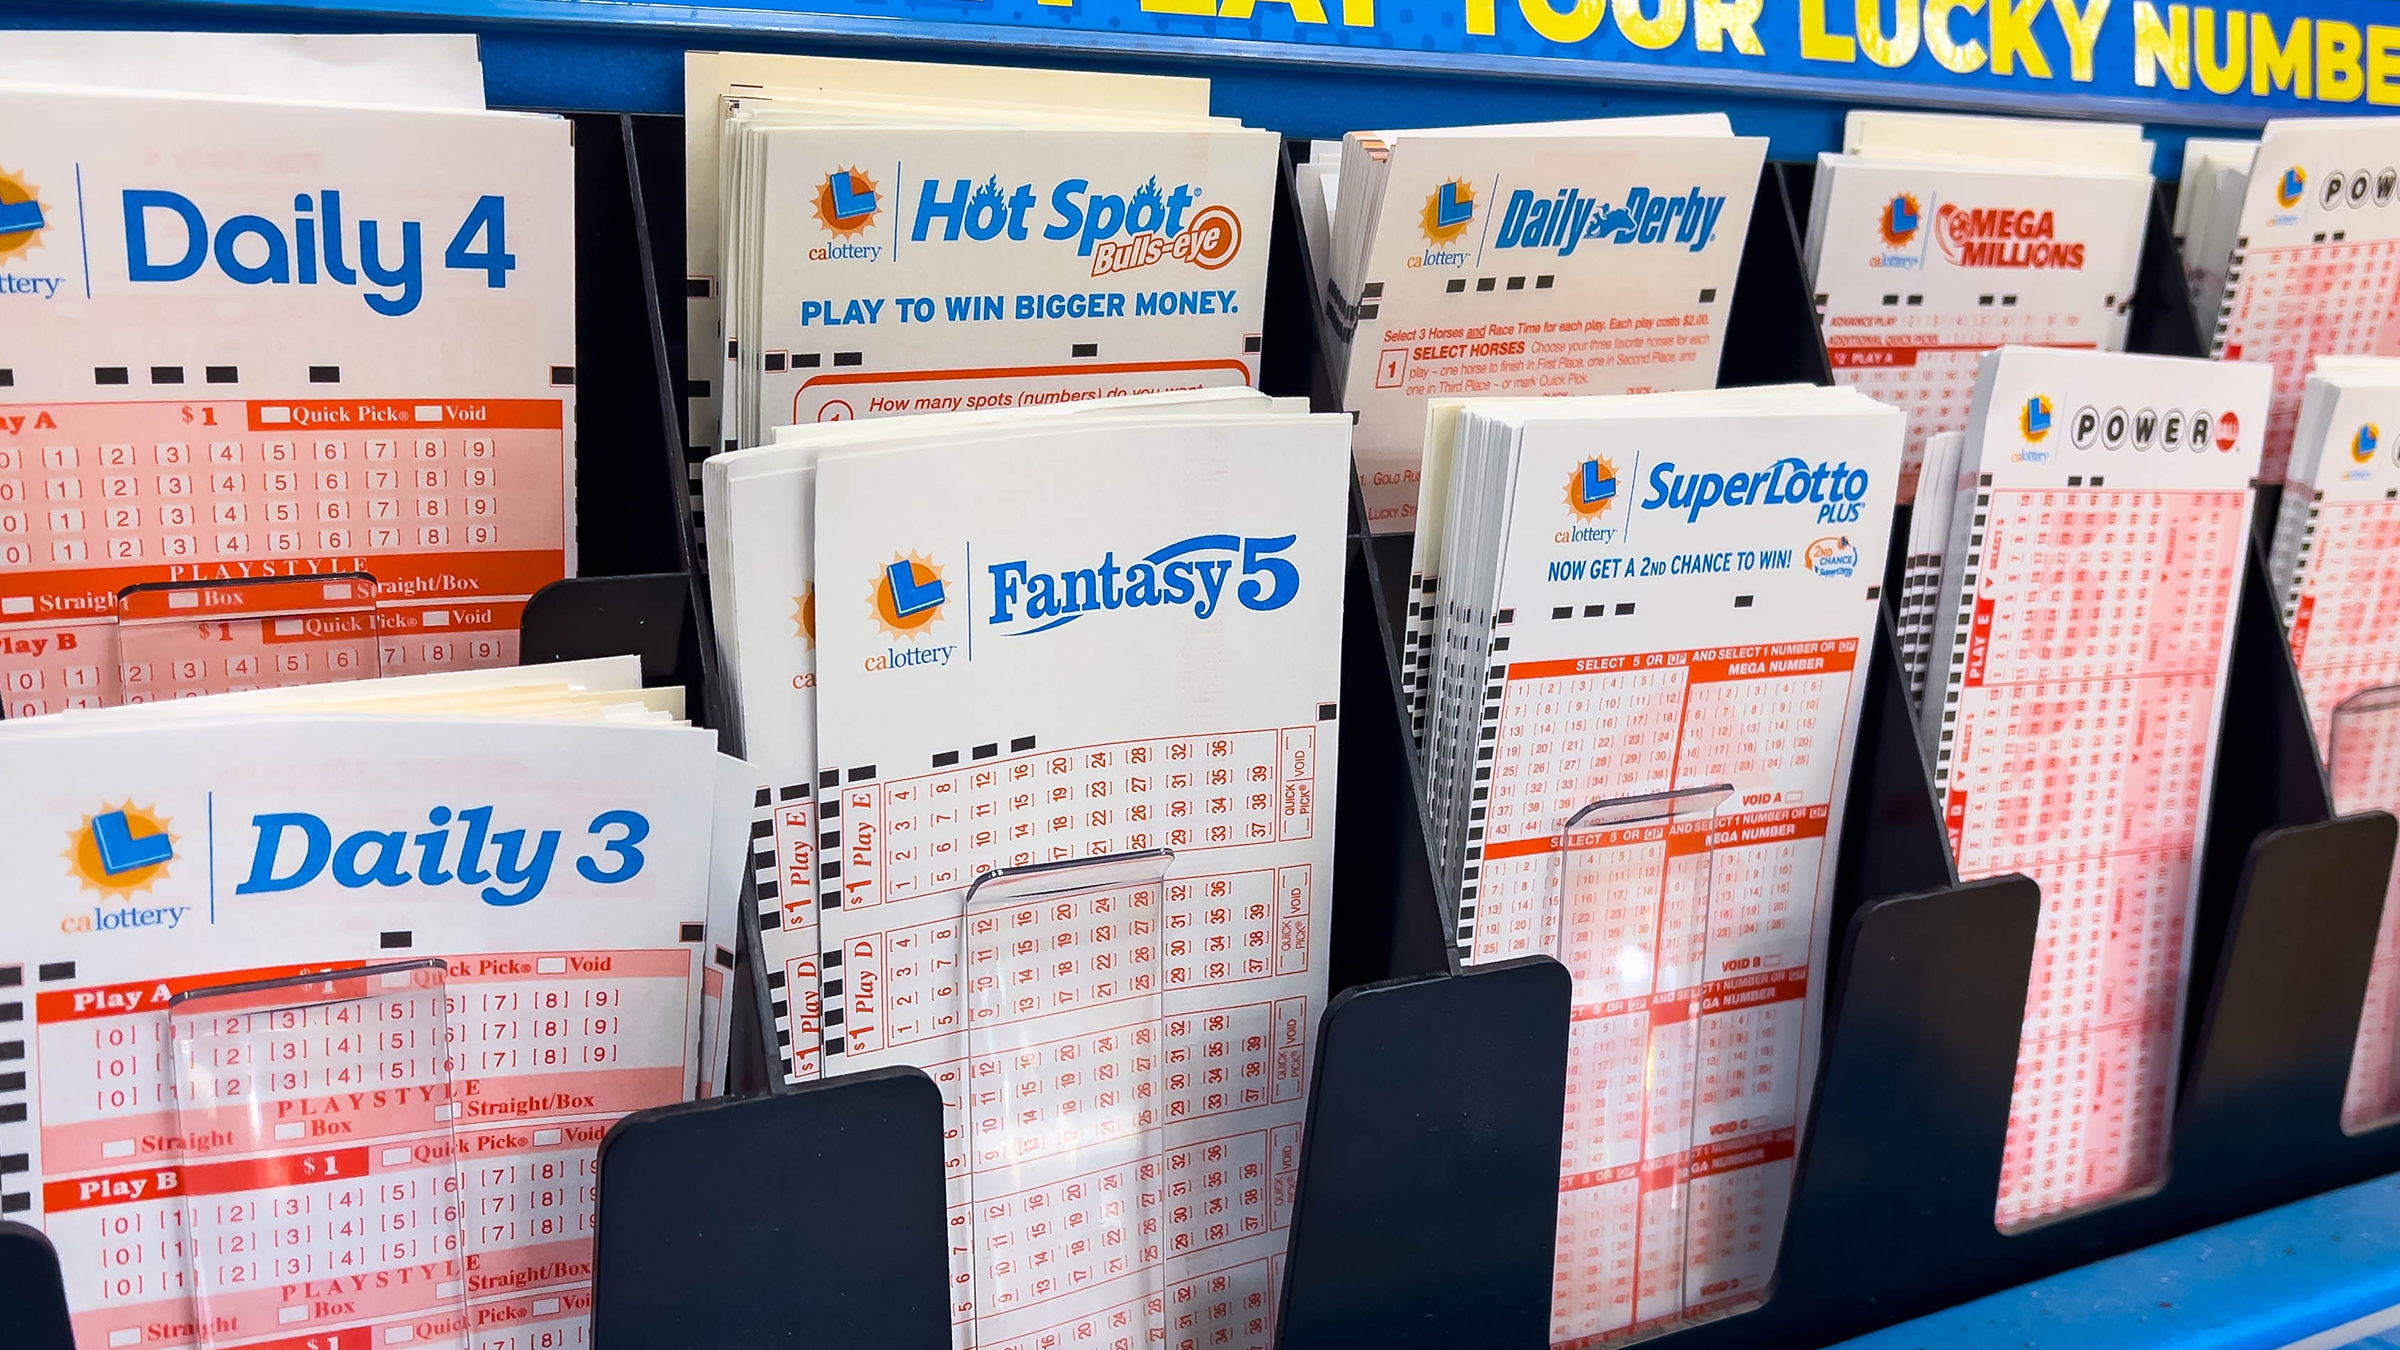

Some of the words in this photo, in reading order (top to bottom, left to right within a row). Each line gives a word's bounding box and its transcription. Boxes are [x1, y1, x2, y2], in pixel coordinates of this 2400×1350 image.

[1800, 0, 2105, 83] LUCKY
[911, 173, 1036, 242] Hot
[1495, 188, 1596, 257] Daily
[1613, 186, 1726, 253] Derby
[1969, 209, 2055, 239] MEGA
[122, 189, 423, 317] Daily
[445, 195, 516, 288] 4
[809, 243, 882, 262] calottery
[1091, 223, 1222, 278] Bulls-eye
[1406, 249, 1471, 269] calottery
[1961, 242, 2085, 270] MILLIONS
[802, 299, 885, 326] PLAY
[895, 298, 935, 323] TO
[946, 296, 1004, 321] WIN
[1015, 293, 1125, 320] BIGGER
[1135, 290, 1238, 316] MONEY.
[1384, 330, 1417, 342] Select
[1419, 328, 1425, 340] 3
[1428, 327, 1464, 340] Horses
[1466, 325, 1486, 339] and
[1489, 324, 1514, 336] Race
[1518, 322, 1541, 334] Time
[1543, 321, 1557, 333] for
[1559, 320, 1582, 332] each
[1609, 317, 1633, 330] Each
[1635, 317, 1654, 331] play
[1656, 316, 1680, 328] costs
[1412, 345, 1467, 361] SELECT
[1470, 341, 1525, 357] HORSES
[1532, 341, 1566, 354] Choose
[1852, 352, 1881, 364] PLAY
[1388, 361, 1396, 378] 1
[1409, 367, 1429, 381] play
[1440, 365, 1458, 376] one
[1461, 363, 1487, 375] horse
[1501, 360, 1524, 372] finish
[1616, 353, 1650, 366] Second
[1439, 381, 1462, 393] Third
[1465, 379, 1491, 392] Place
[869, 396, 909, 413] How
[914, 398, 963, 412] many
[966, 393, 1012, 411] spots
[1018, 387, 1102, 408] (numbers)
[34, 411, 57, 430] A
[293, 406, 351, 425] Quick
[446, 405, 487, 422] Void
[1374, 471, 1400, 486] GOLD
[1641, 457, 1869, 523] SuperLotto
[1554, 526, 1618, 544] calottery
[1548, 560, 1587, 582] NOW
[1589, 558, 1622, 579] GET
[1624, 559, 1635, 578] A
[1640, 557, 1666, 577] 2ND
[1670, 552, 1732, 574] CHANCE
[1736, 551, 1755, 572] TO
[1759, 549, 1793, 570] WIN!
[988, 535, 1240, 633] Fantasy
[1237, 533, 1300, 613] 5
[205, 590, 244, 607] Box
[57, 633, 77, 650] B
[305, 617, 362, 637] Quick
[453, 609, 493, 625] Void
[864, 644, 957, 673] calottery
[1575, 657, 1625, 671] SELECT
[1632, 657, 1640, 667] 5
[1646, 655, 1663, 667] OR
[1691, 651, 1717, 663] AND
[1718, 647, 1761, 660] SELECT
[1770, 642, 1818, 657] NUMBER
[1820, 641, 1834, 652] OR
[1970, 636, 1985, 679] PLAY
[1728, 661, 1766, 676] MEGA
[1769, 658, 1824, 673] NUMBER
[1294, 750, 1306, 778] VOID
[852, 792, 872, 809] E
[1285, 784, 1296, 817] QUICK
[1742, 794, 1772, 806] VOID
[1772, 793, 1782, 803] A
[786, 810, 807, 828] E
[1668, 825, 1693, 837] AND
[1742, 811, 1789, 825] NUMBER
[1741, 824, 1795, 840] NUMBER
[852, 820, 878, 867] Play
[1623, 830, 1640, 841] OR
[236, 805, 561, 907] Daily
[576, 810, 650, 884] 3
[790, 840, 815, 887] Play
[1291, 887, 1302, 915] VOID
[61, 906, 191, 935] calottery
[1281, 920, 1292, 952] QUICK
[854, 941, 874, 959] D
[571, 956, 611, 972] Void
[798, 960, 818, 978] D
[1721, 959, 1750, 972] VOID
[73, 990, 143, 1013] Play
[150, 983, 172, 1004] A
[855, 969, 878, 1014] Play
[1287, 1018, 1297, 1045] VOID
[1277, 1049, 1288, 1081] QUICK
[141, 1129, 234, 1153] Straight
[312, 1118, 353, 1137] Box
[467, 1092, 594, 1118] Straight/Box
[565, 1125, 606, 1143] Void
[1282, 1145, 1293, 1171] VOID
[79, 1178, 148, 1202] Play
[157, 1171, 178, 1190] B
[315, 1301, 356, 1319] Box
[468, 1261, 591, 1293] Straight/Box
